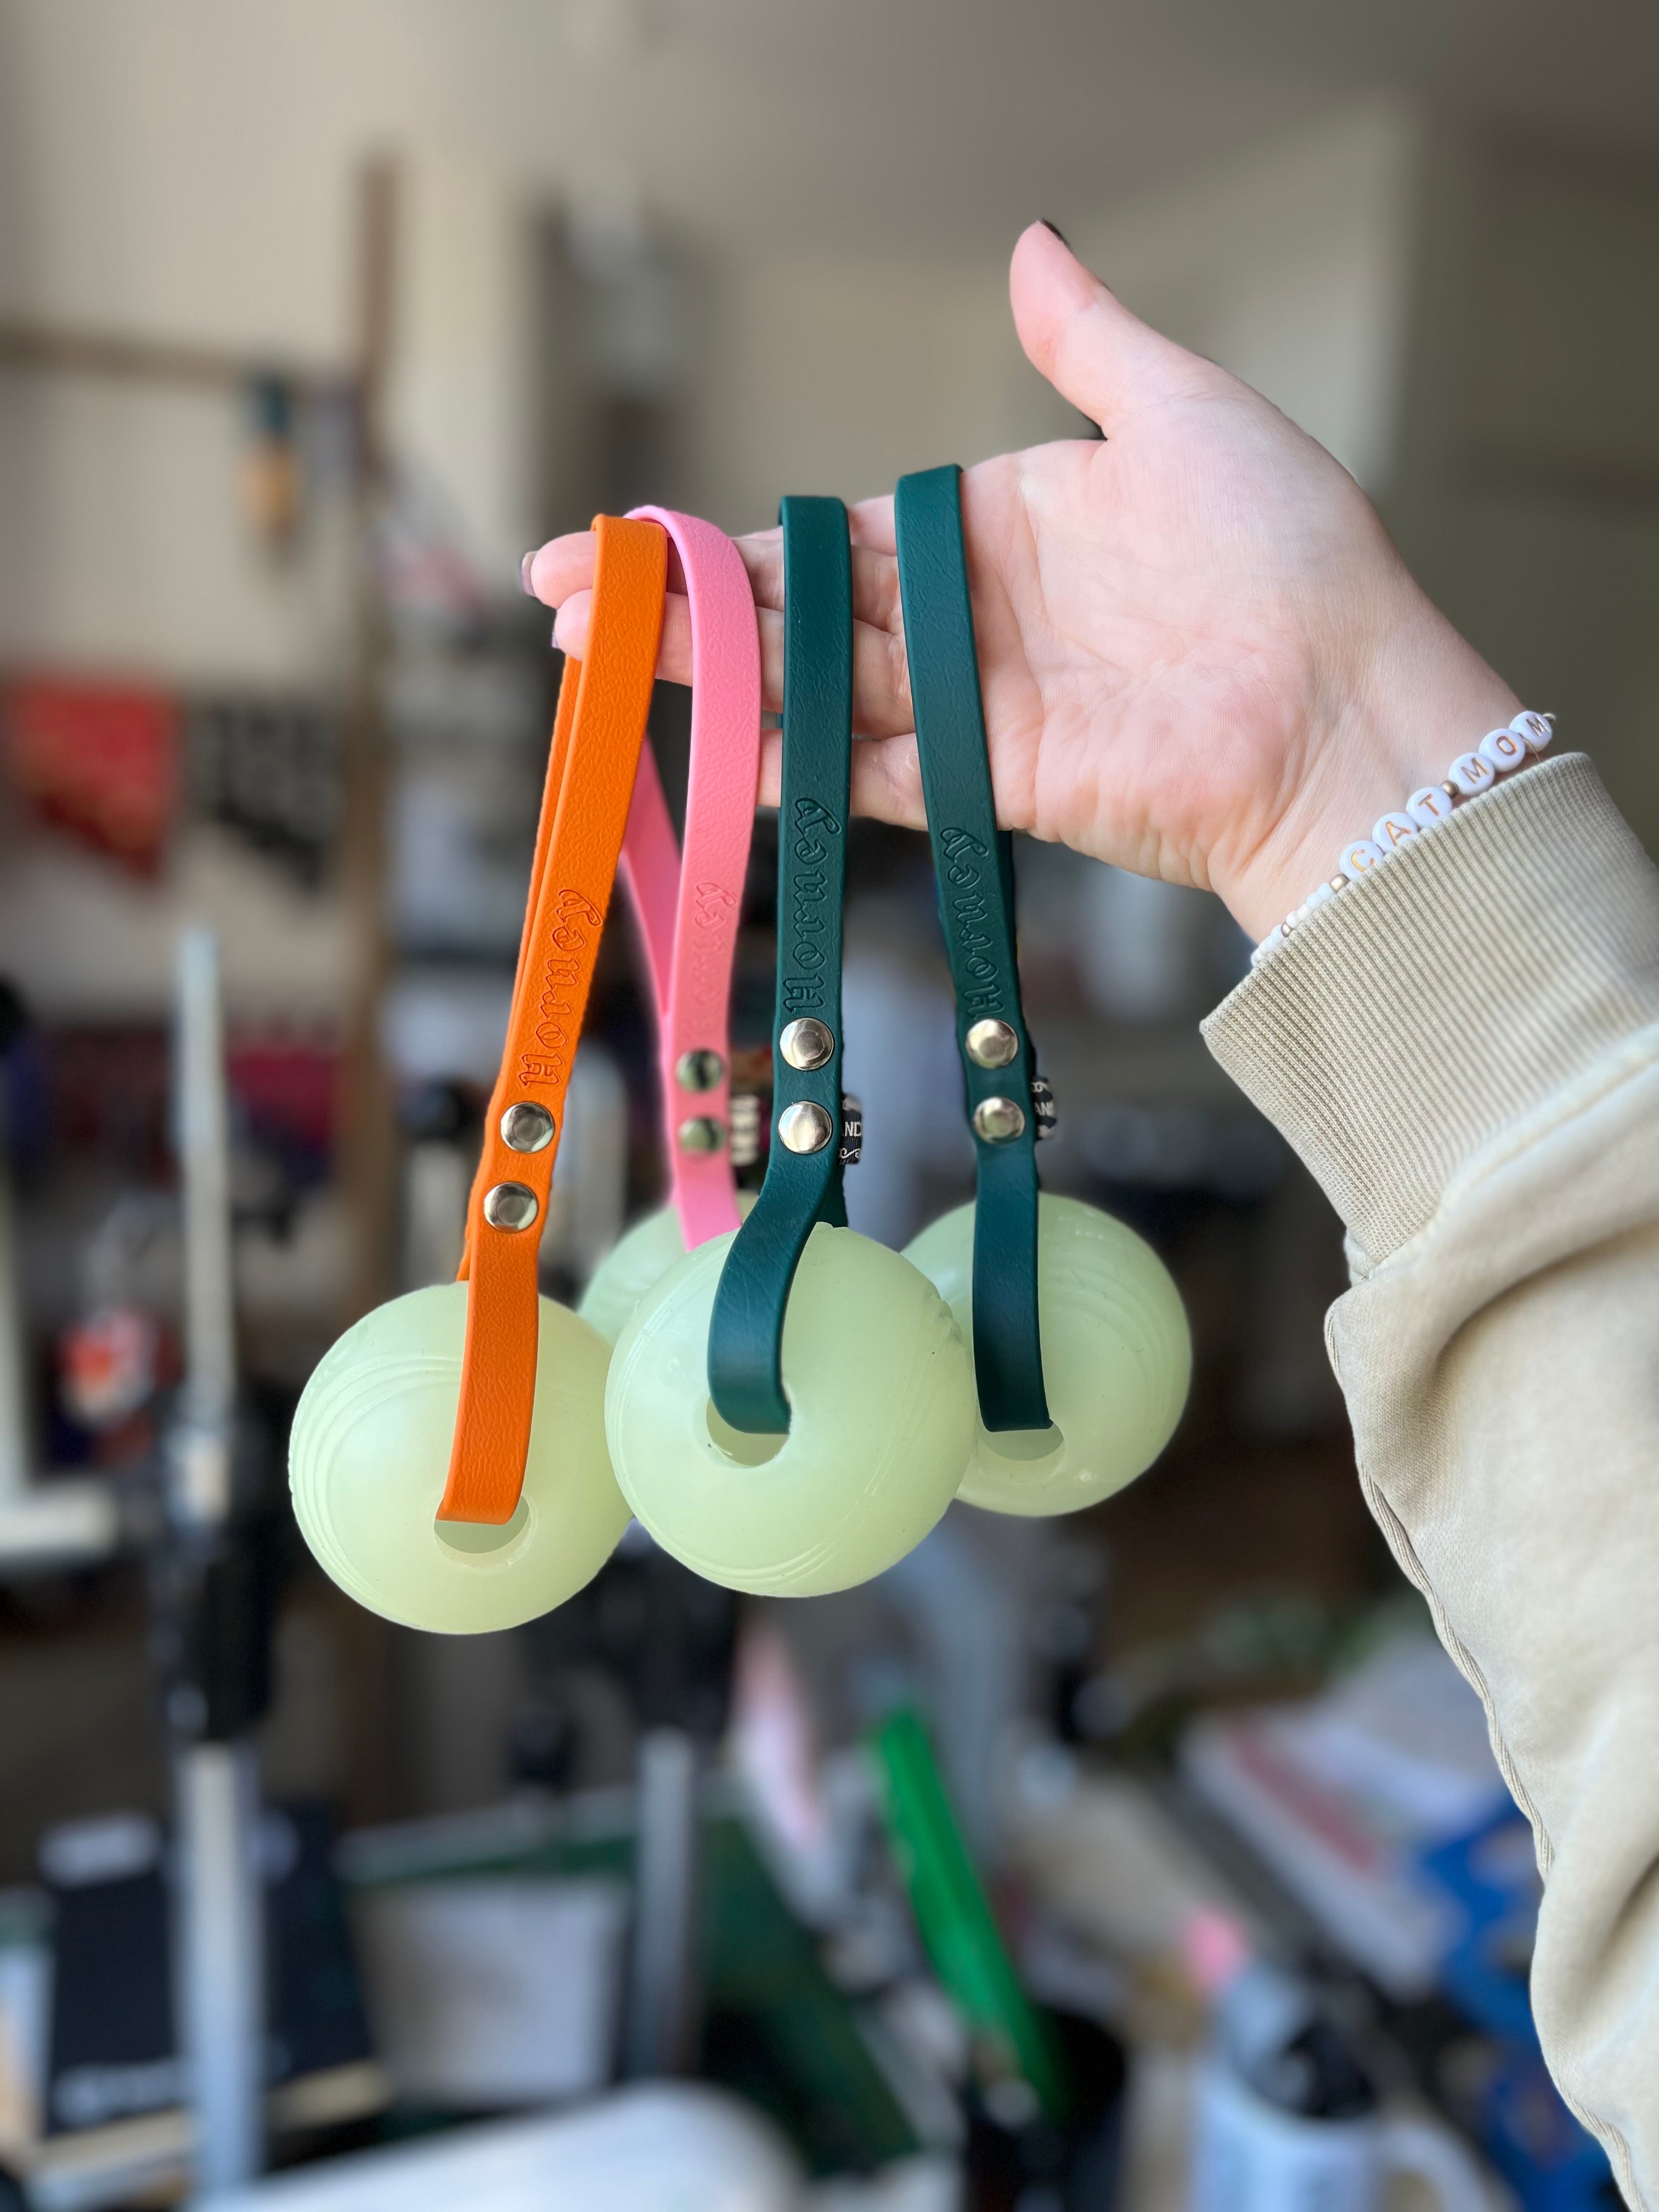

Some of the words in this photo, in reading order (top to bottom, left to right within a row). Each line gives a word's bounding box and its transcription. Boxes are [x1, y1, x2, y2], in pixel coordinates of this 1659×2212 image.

[1351, 793, 1440, 873] CAT
[1460, 715, 1550, 785] MOM
[518, 889, 603, 1088] Horney
[782, 797, 842, 1013] Horney
[940, 826, 1005, 1020] Horney
[842, 1121, 861, 1137] ND
